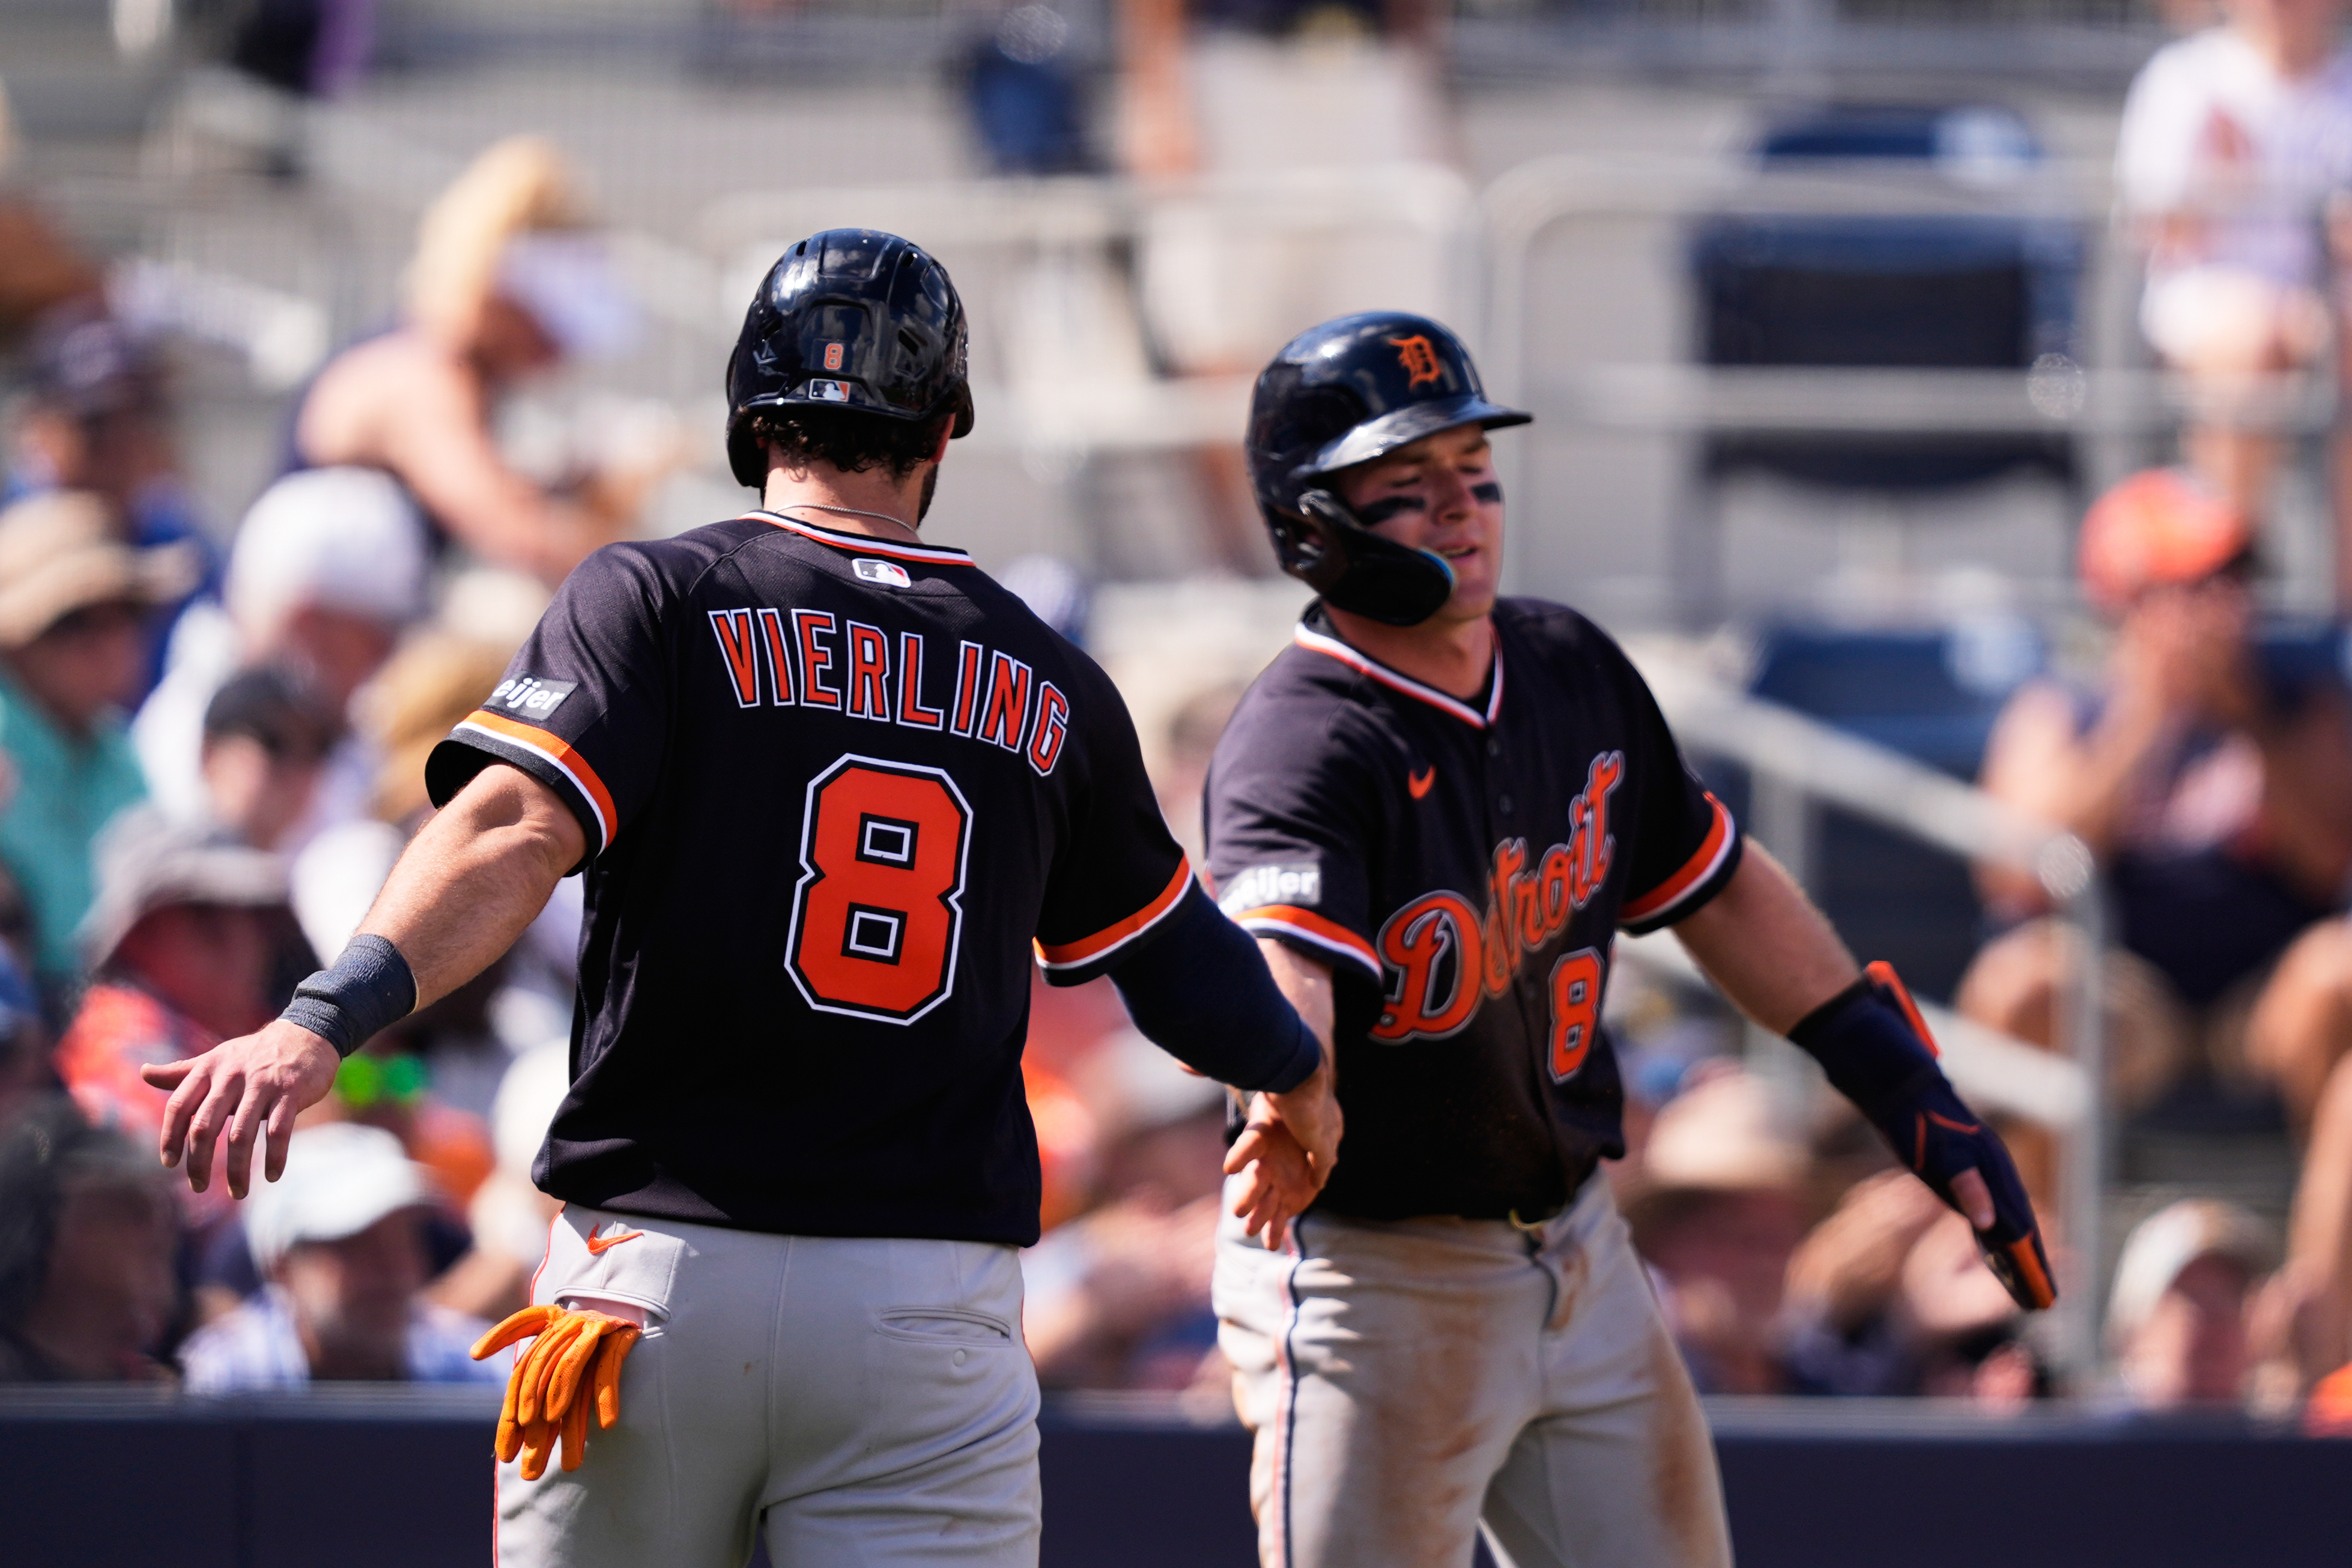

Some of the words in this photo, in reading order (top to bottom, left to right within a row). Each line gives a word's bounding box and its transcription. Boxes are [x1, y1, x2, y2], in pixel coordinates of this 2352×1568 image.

[824, 343, 843, 370] 8
[1389, 334, 1441, 390] D
[492, 677, 566, 710] eijer
[708, 608, 1069, 776] VIERLING
[784, 752, 974, 1026] 8
[1368, 750, 1624, 1046] Detroit
[1548, 946, 1604, 1083] 8
